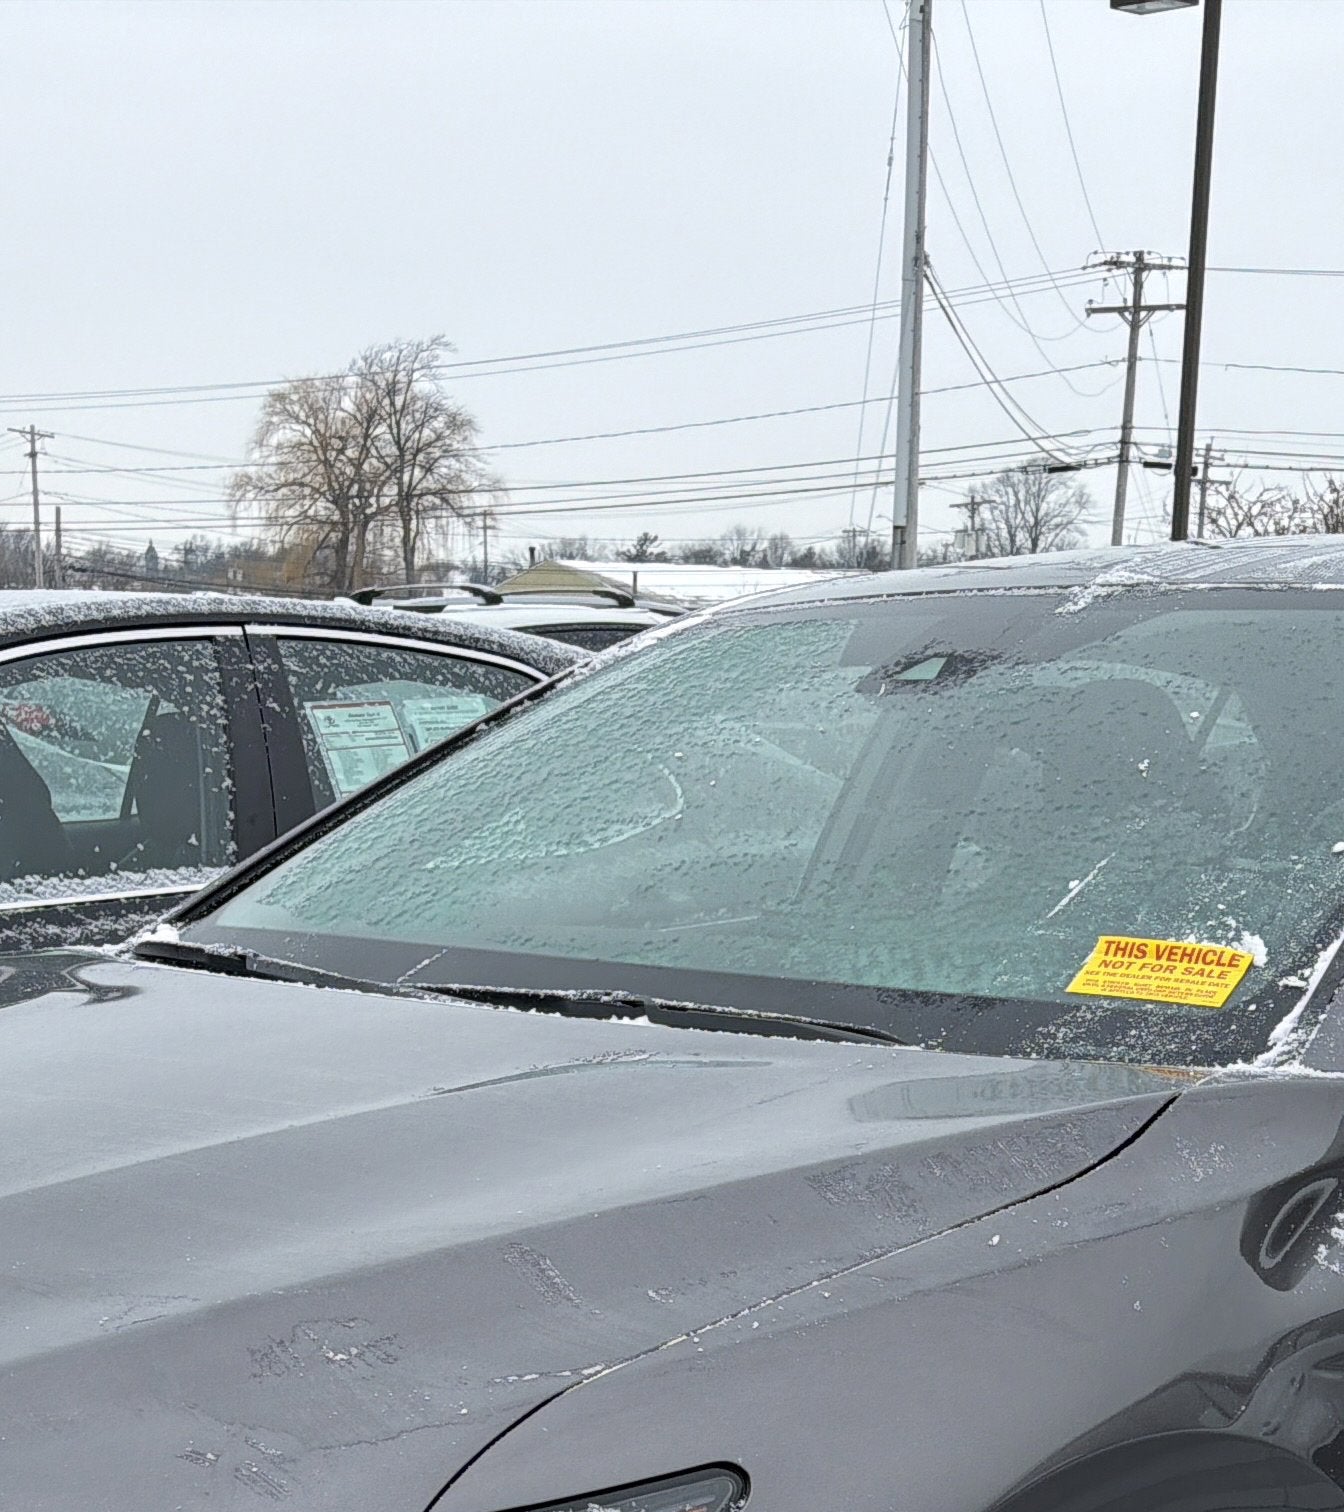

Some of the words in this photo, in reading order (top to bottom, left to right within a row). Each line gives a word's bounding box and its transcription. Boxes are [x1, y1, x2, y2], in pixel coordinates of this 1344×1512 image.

[1103, 940, 1148, 960] THIS
[1154, 945, 1244, 968] VEHICLE
[1097, 959, 1136, 970] NOT
[1138, 963, 1177, 974] FOR
[1181, 967, 1230, 979] SALE
